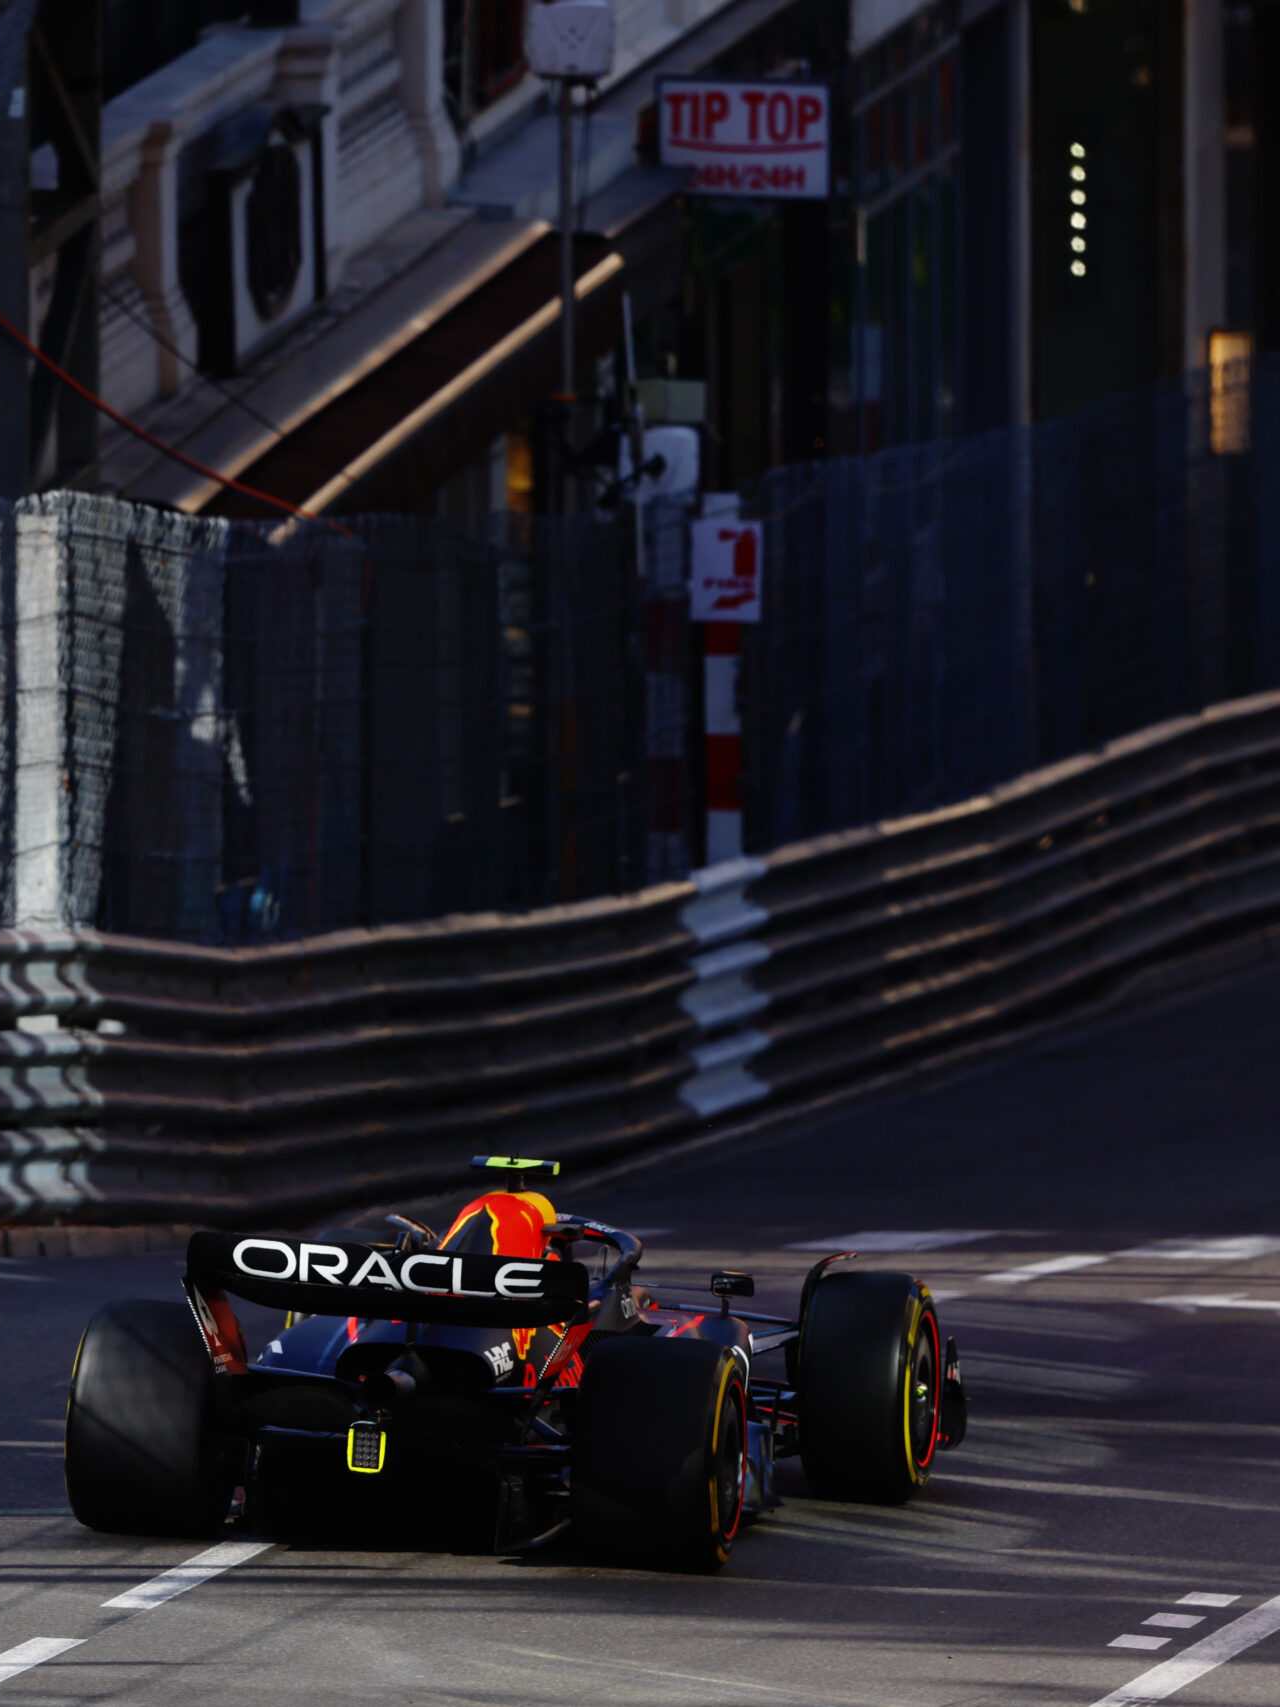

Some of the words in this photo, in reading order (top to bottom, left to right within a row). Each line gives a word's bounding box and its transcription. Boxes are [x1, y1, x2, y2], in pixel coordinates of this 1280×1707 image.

[666, 91, 729, 140] TIP
[742, 91, 822, 143] TOP
[233, 1239, 544, 1298] ORACLE
